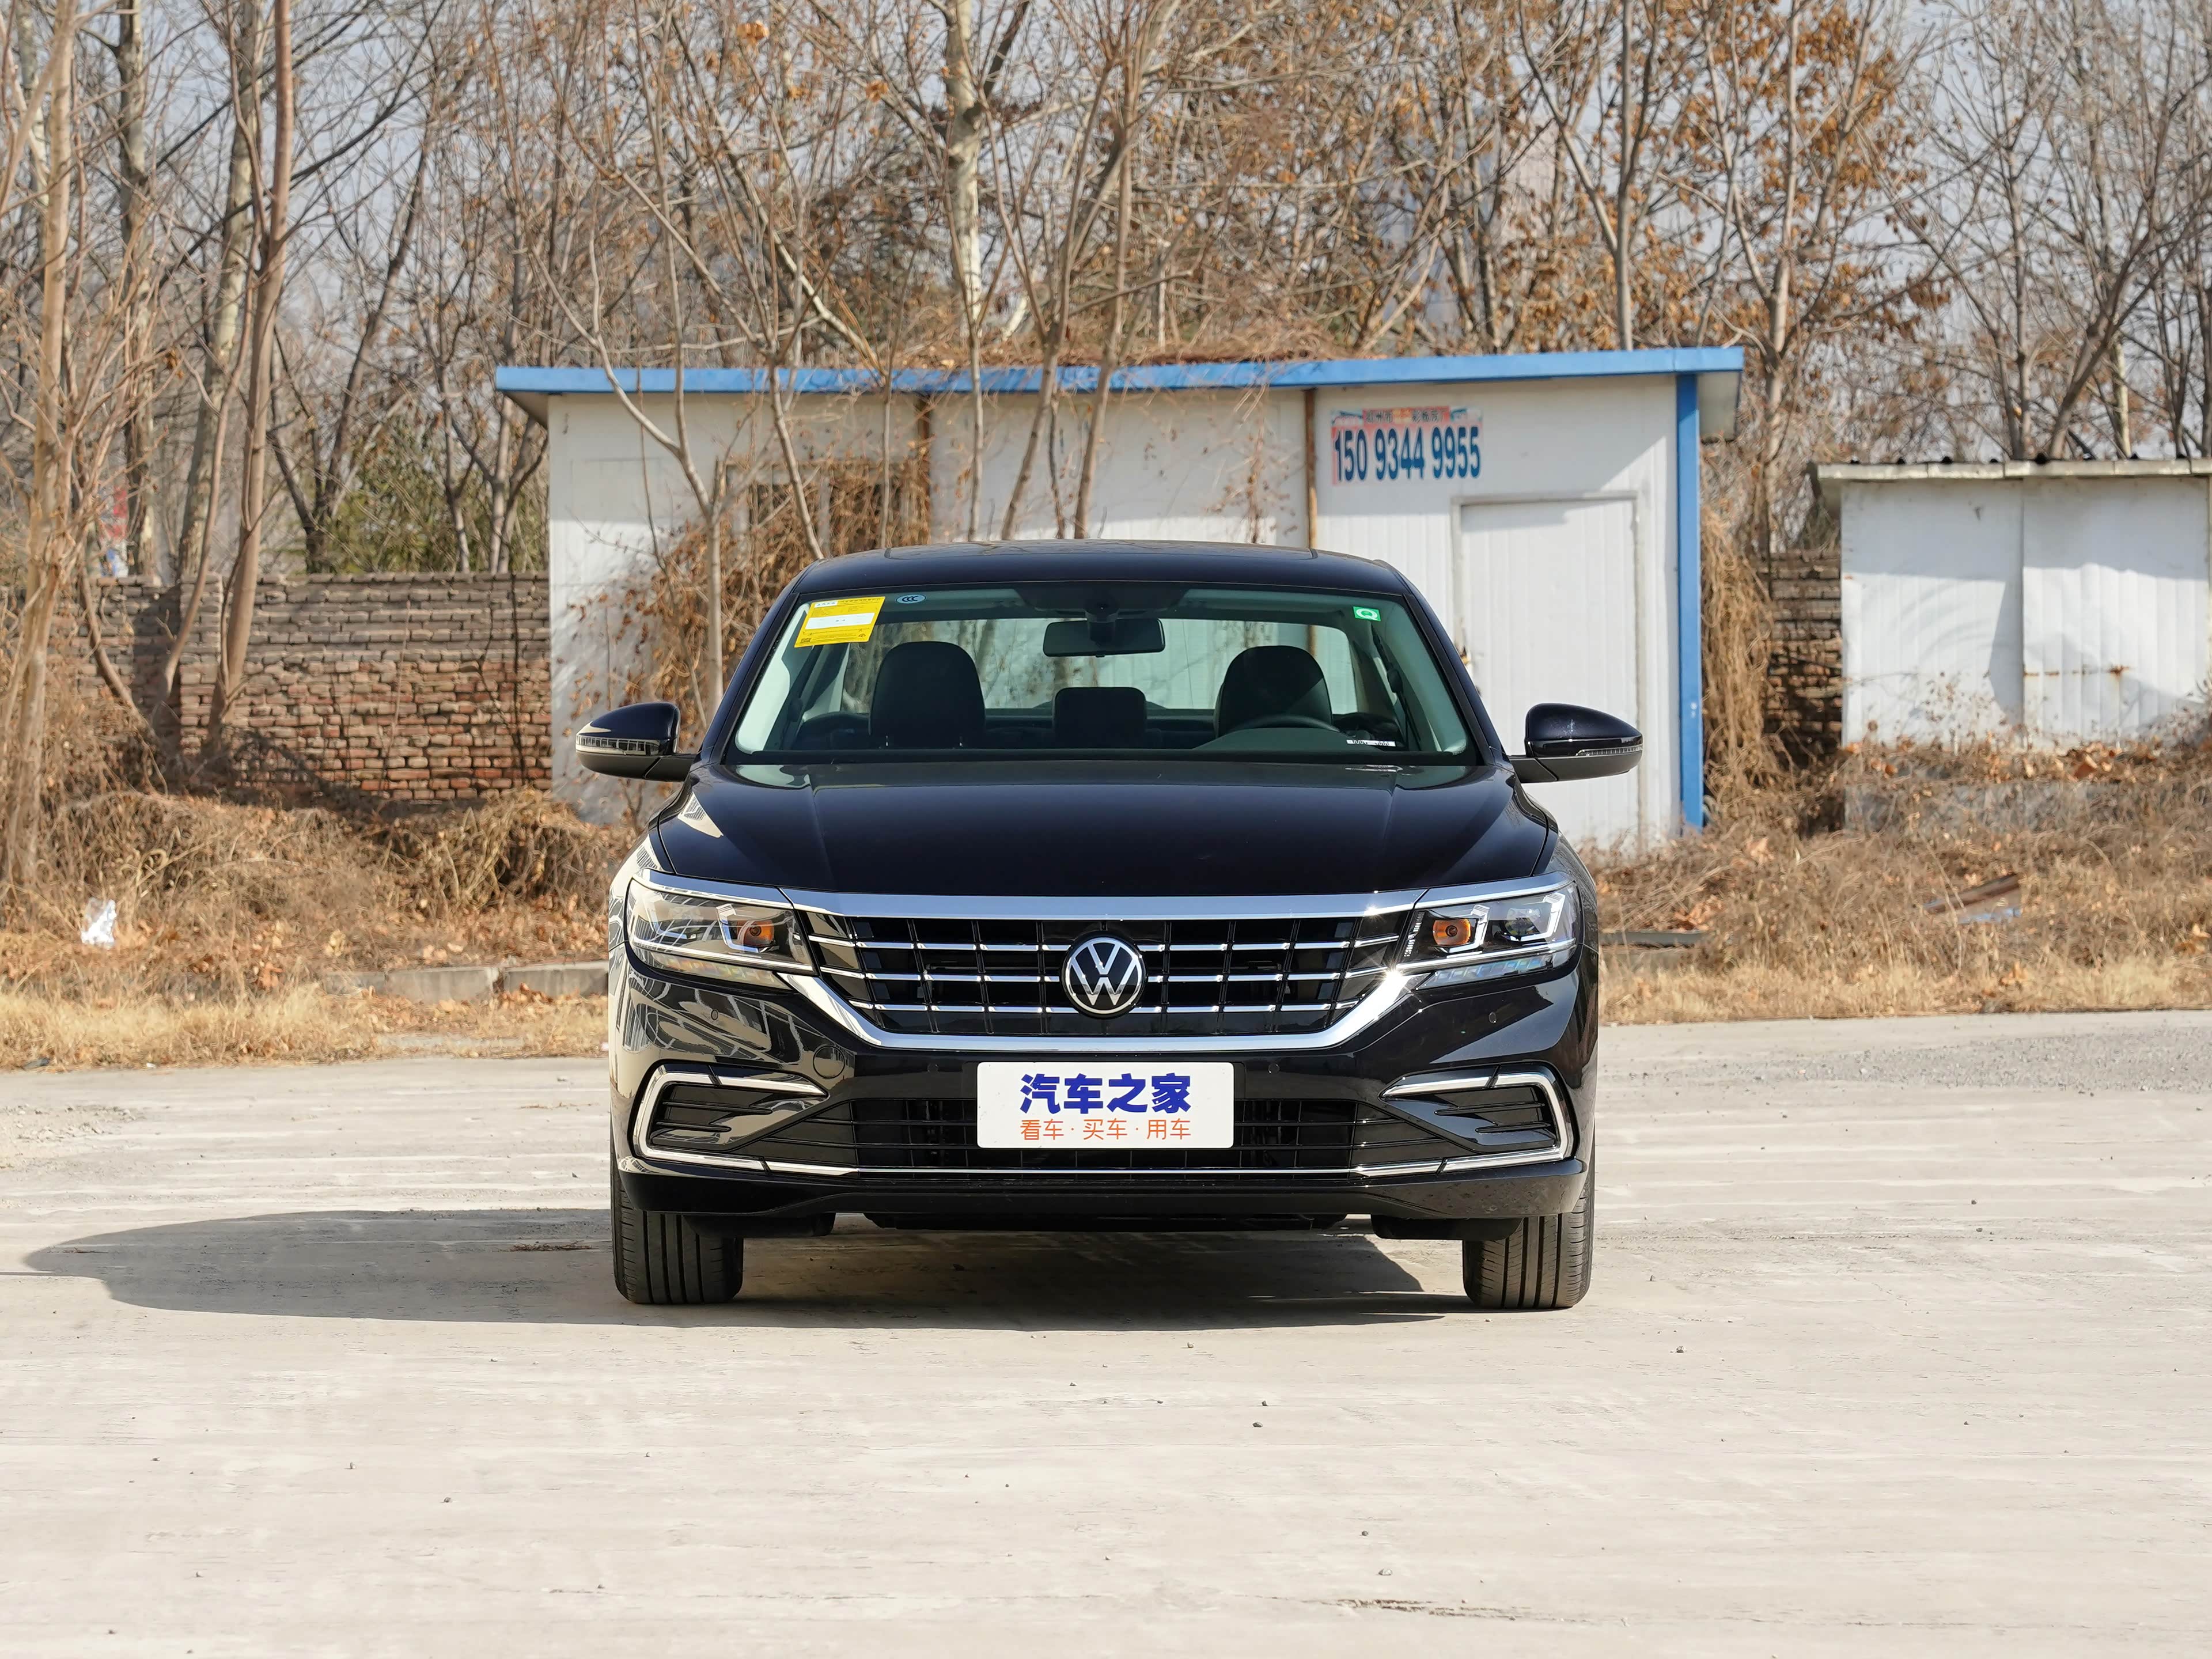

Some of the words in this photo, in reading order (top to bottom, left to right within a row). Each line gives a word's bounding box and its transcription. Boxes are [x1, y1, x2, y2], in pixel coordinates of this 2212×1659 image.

[1335, 428, 1367, 481] 150
[1375, 427, 1425, 480] 9344
[1431, 426, 1480, 479] 9955
[1020, 1073, 1191, 1114] 汽车之家
